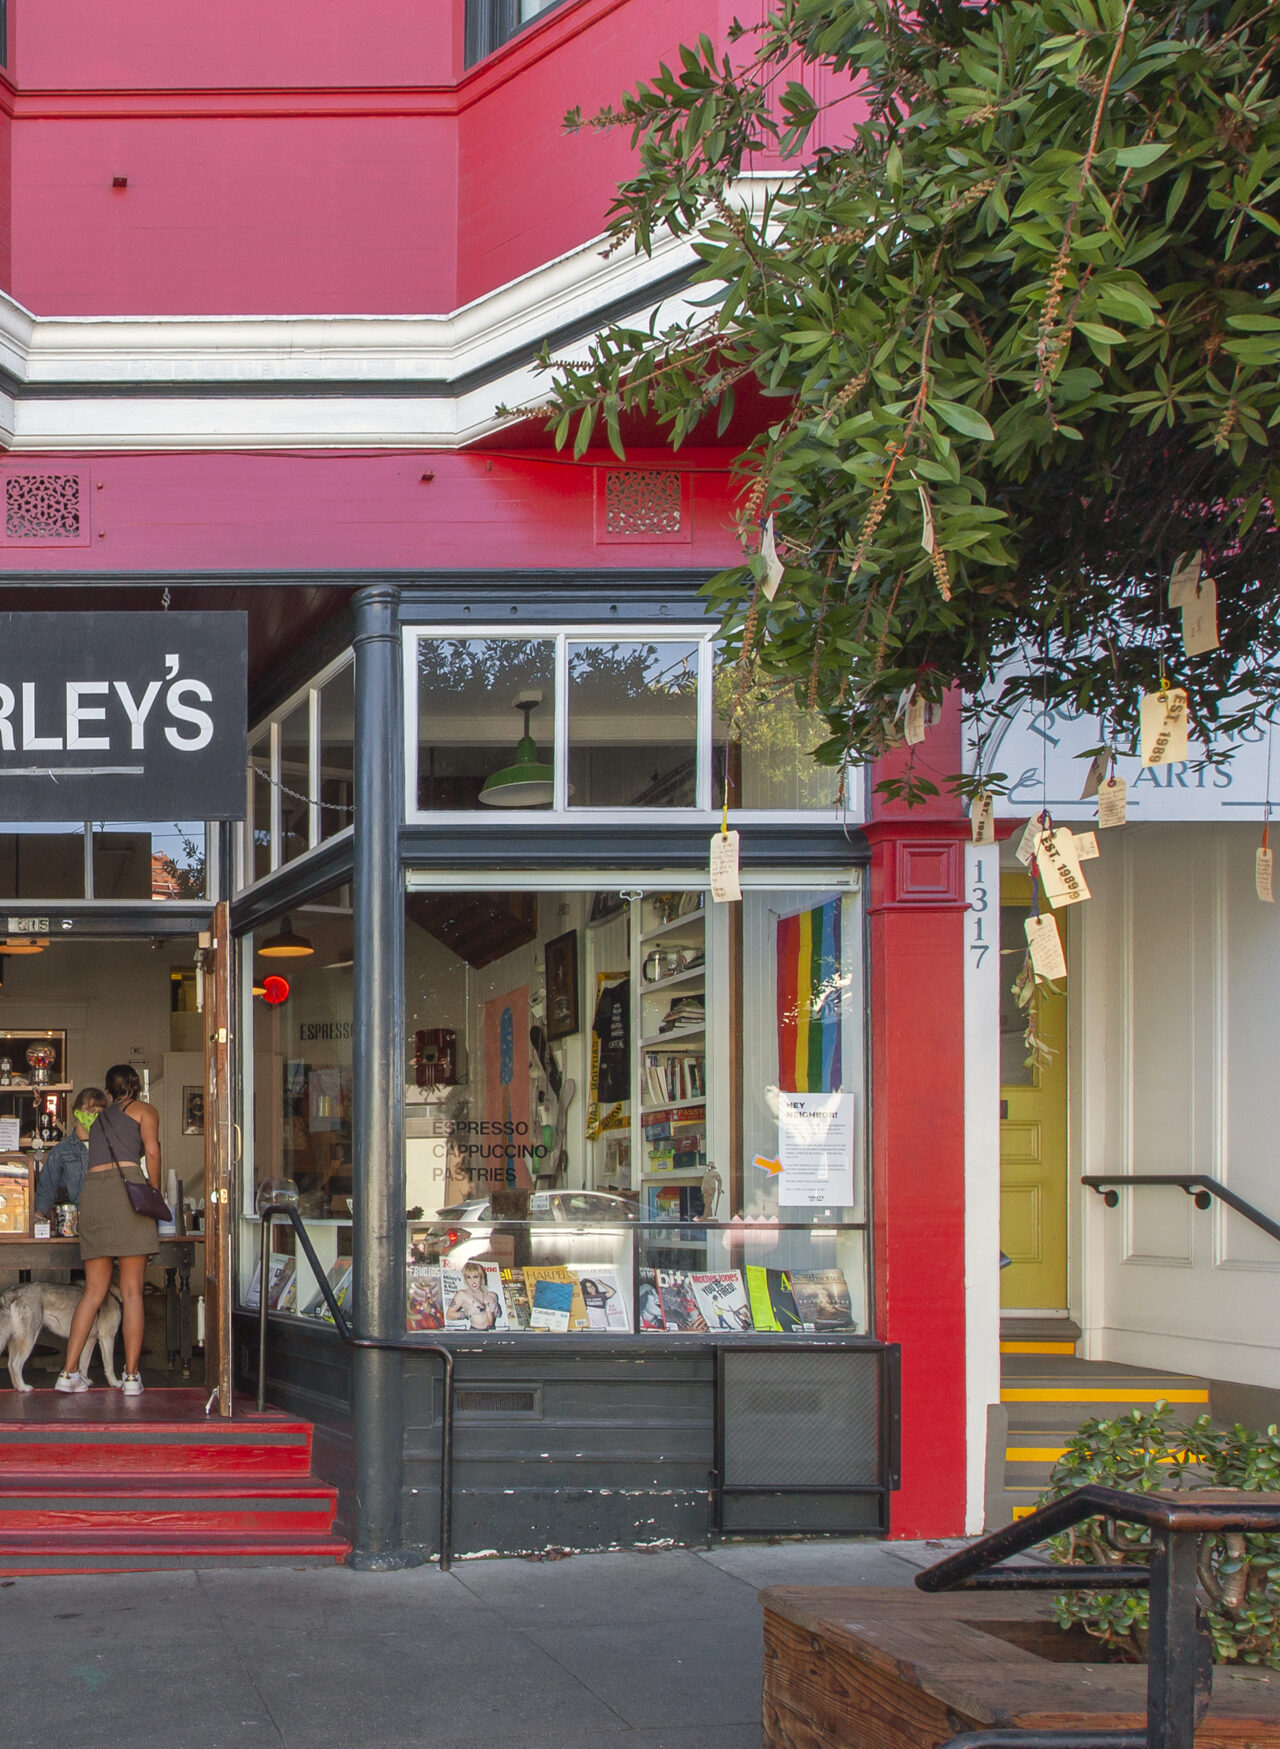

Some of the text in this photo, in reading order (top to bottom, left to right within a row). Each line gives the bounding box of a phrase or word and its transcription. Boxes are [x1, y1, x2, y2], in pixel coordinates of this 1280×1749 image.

[1149, 693, 1186, 763] EST. 1989
[1130, 760, 1233, 789] ARTS
[1039, 836, 1061, 863] EST.
[1057, 863, 1080, 890] 1989
[969, 859, 990, 970] 1317
[432, 1121, 529, 1136] ESPRESSO
[432, 1144, 548, 1159] CAPPUCCINO
[432, 1167, 517, 1182] PASTRIES
